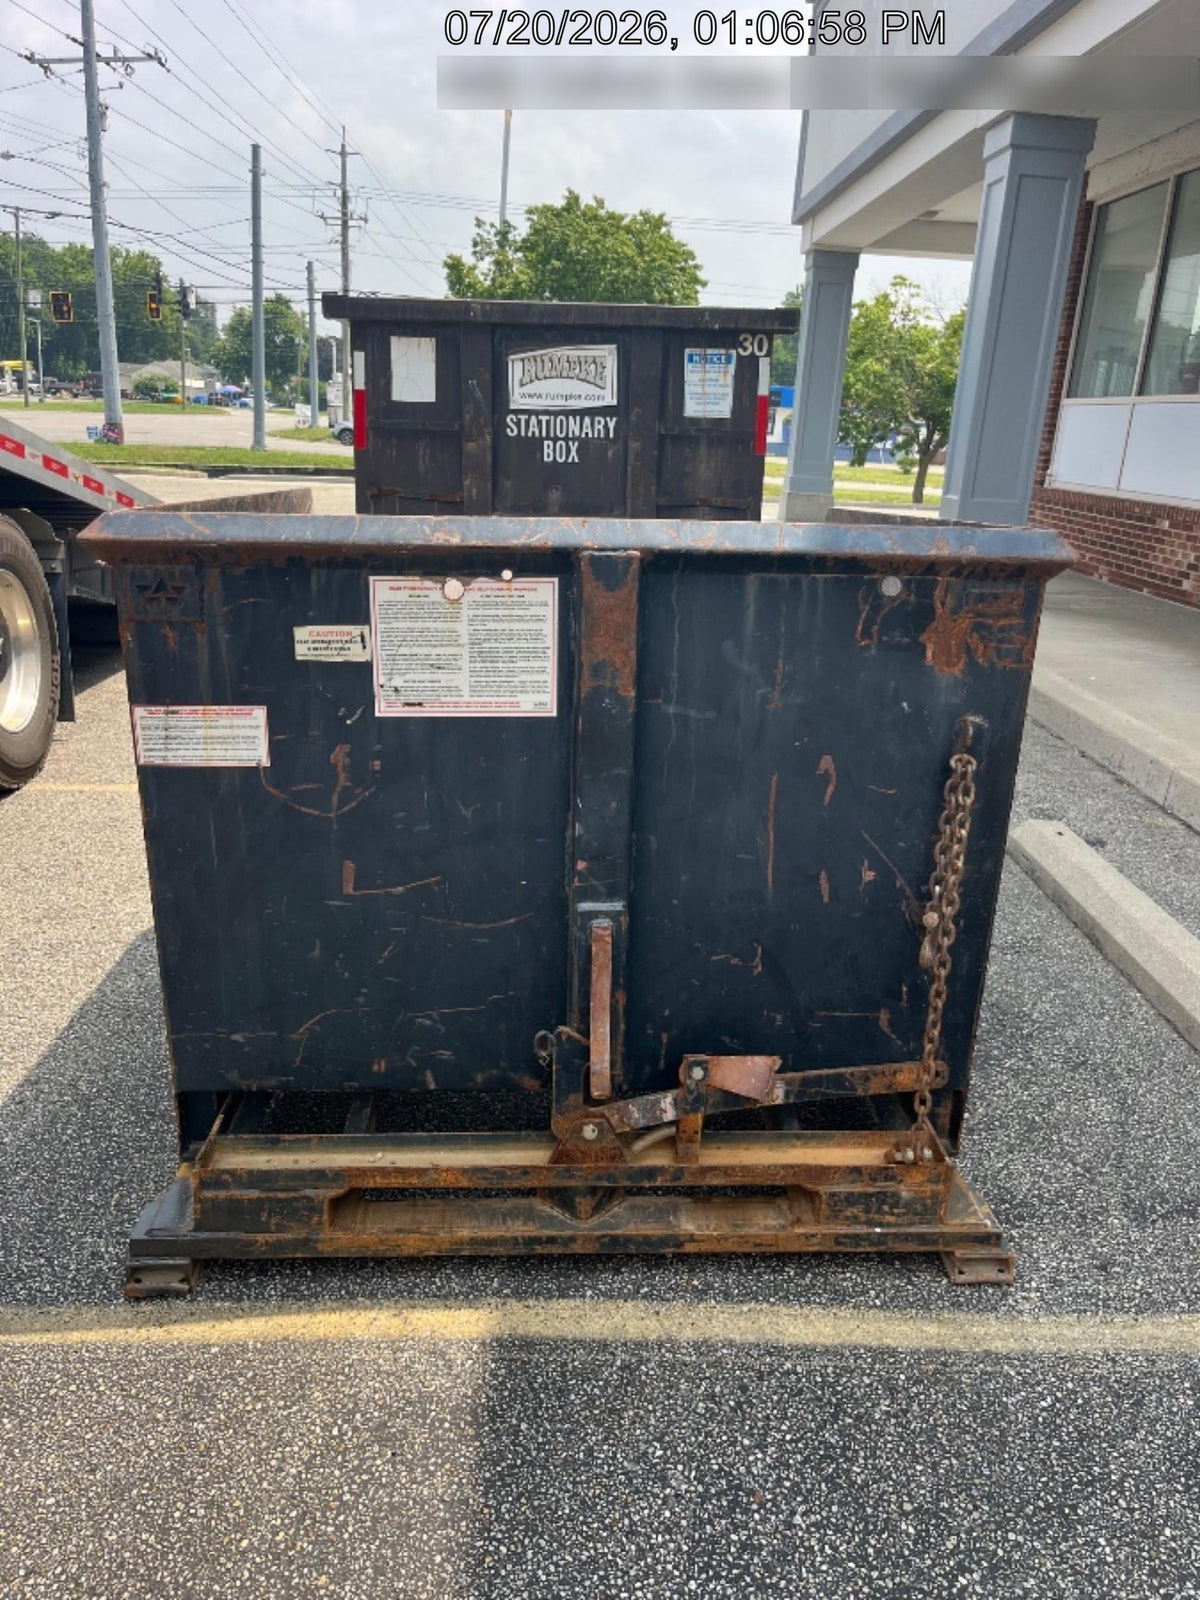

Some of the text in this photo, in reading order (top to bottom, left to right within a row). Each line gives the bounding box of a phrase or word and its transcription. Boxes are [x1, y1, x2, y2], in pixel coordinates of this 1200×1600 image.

[737, 332, 769, 356] 30
[519, 353, 606, 390] RUMPKE
[519, 391, 606, 403] www.rumpke.com
[505, 413, 617, 439] STATIONARY
[543, 440, 579, 464] BOX
[308, 630, 353, 638] CAUTION
